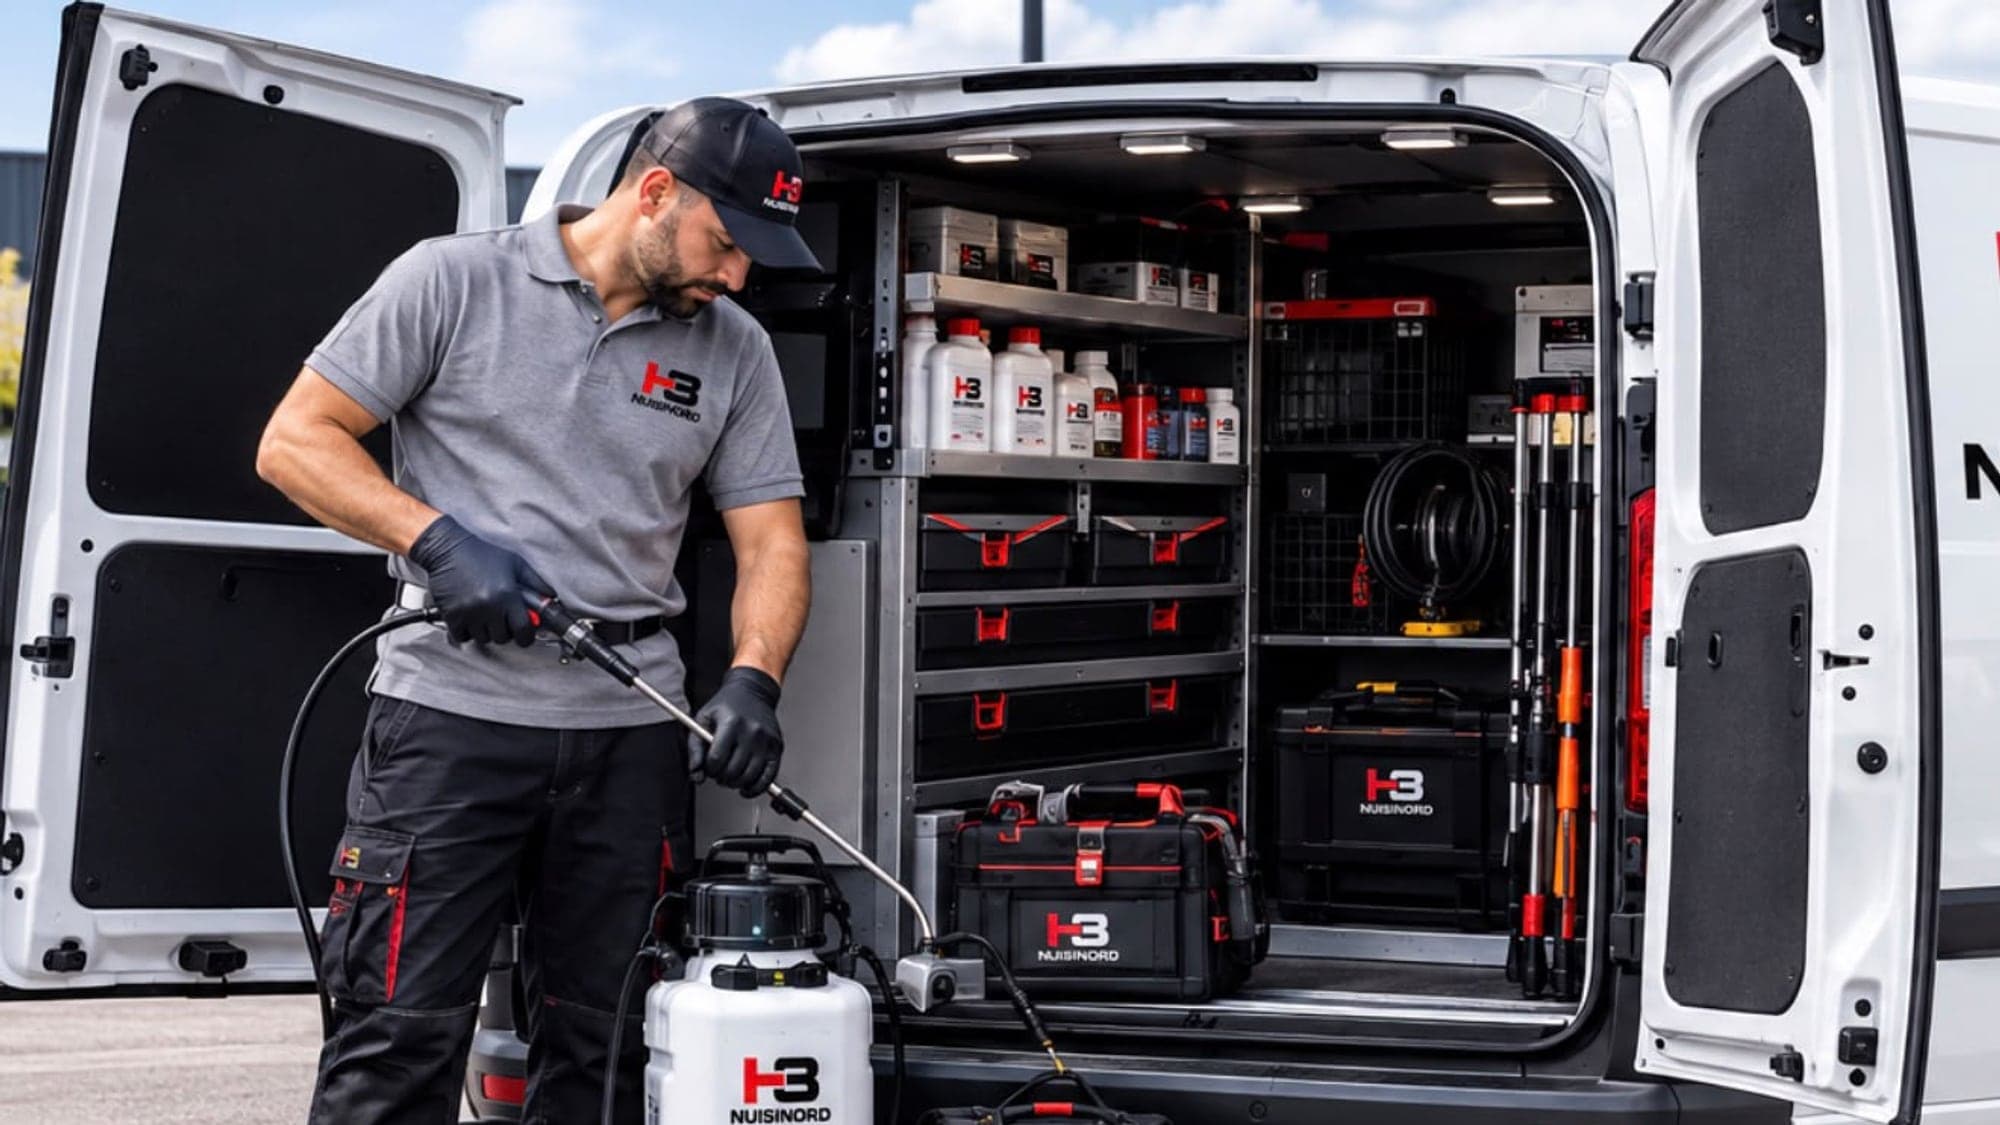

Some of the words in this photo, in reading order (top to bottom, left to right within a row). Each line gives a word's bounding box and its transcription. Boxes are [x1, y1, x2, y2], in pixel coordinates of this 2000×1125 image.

[1366, 767, 1424, 802] H3
[1046, 912, 1110, 948] H3
[1038, 949, 1120, 962] NUISINORD
[743, 1056, 820, 1105] H3
[730, 1107, 832, 1125] NUISINORD
